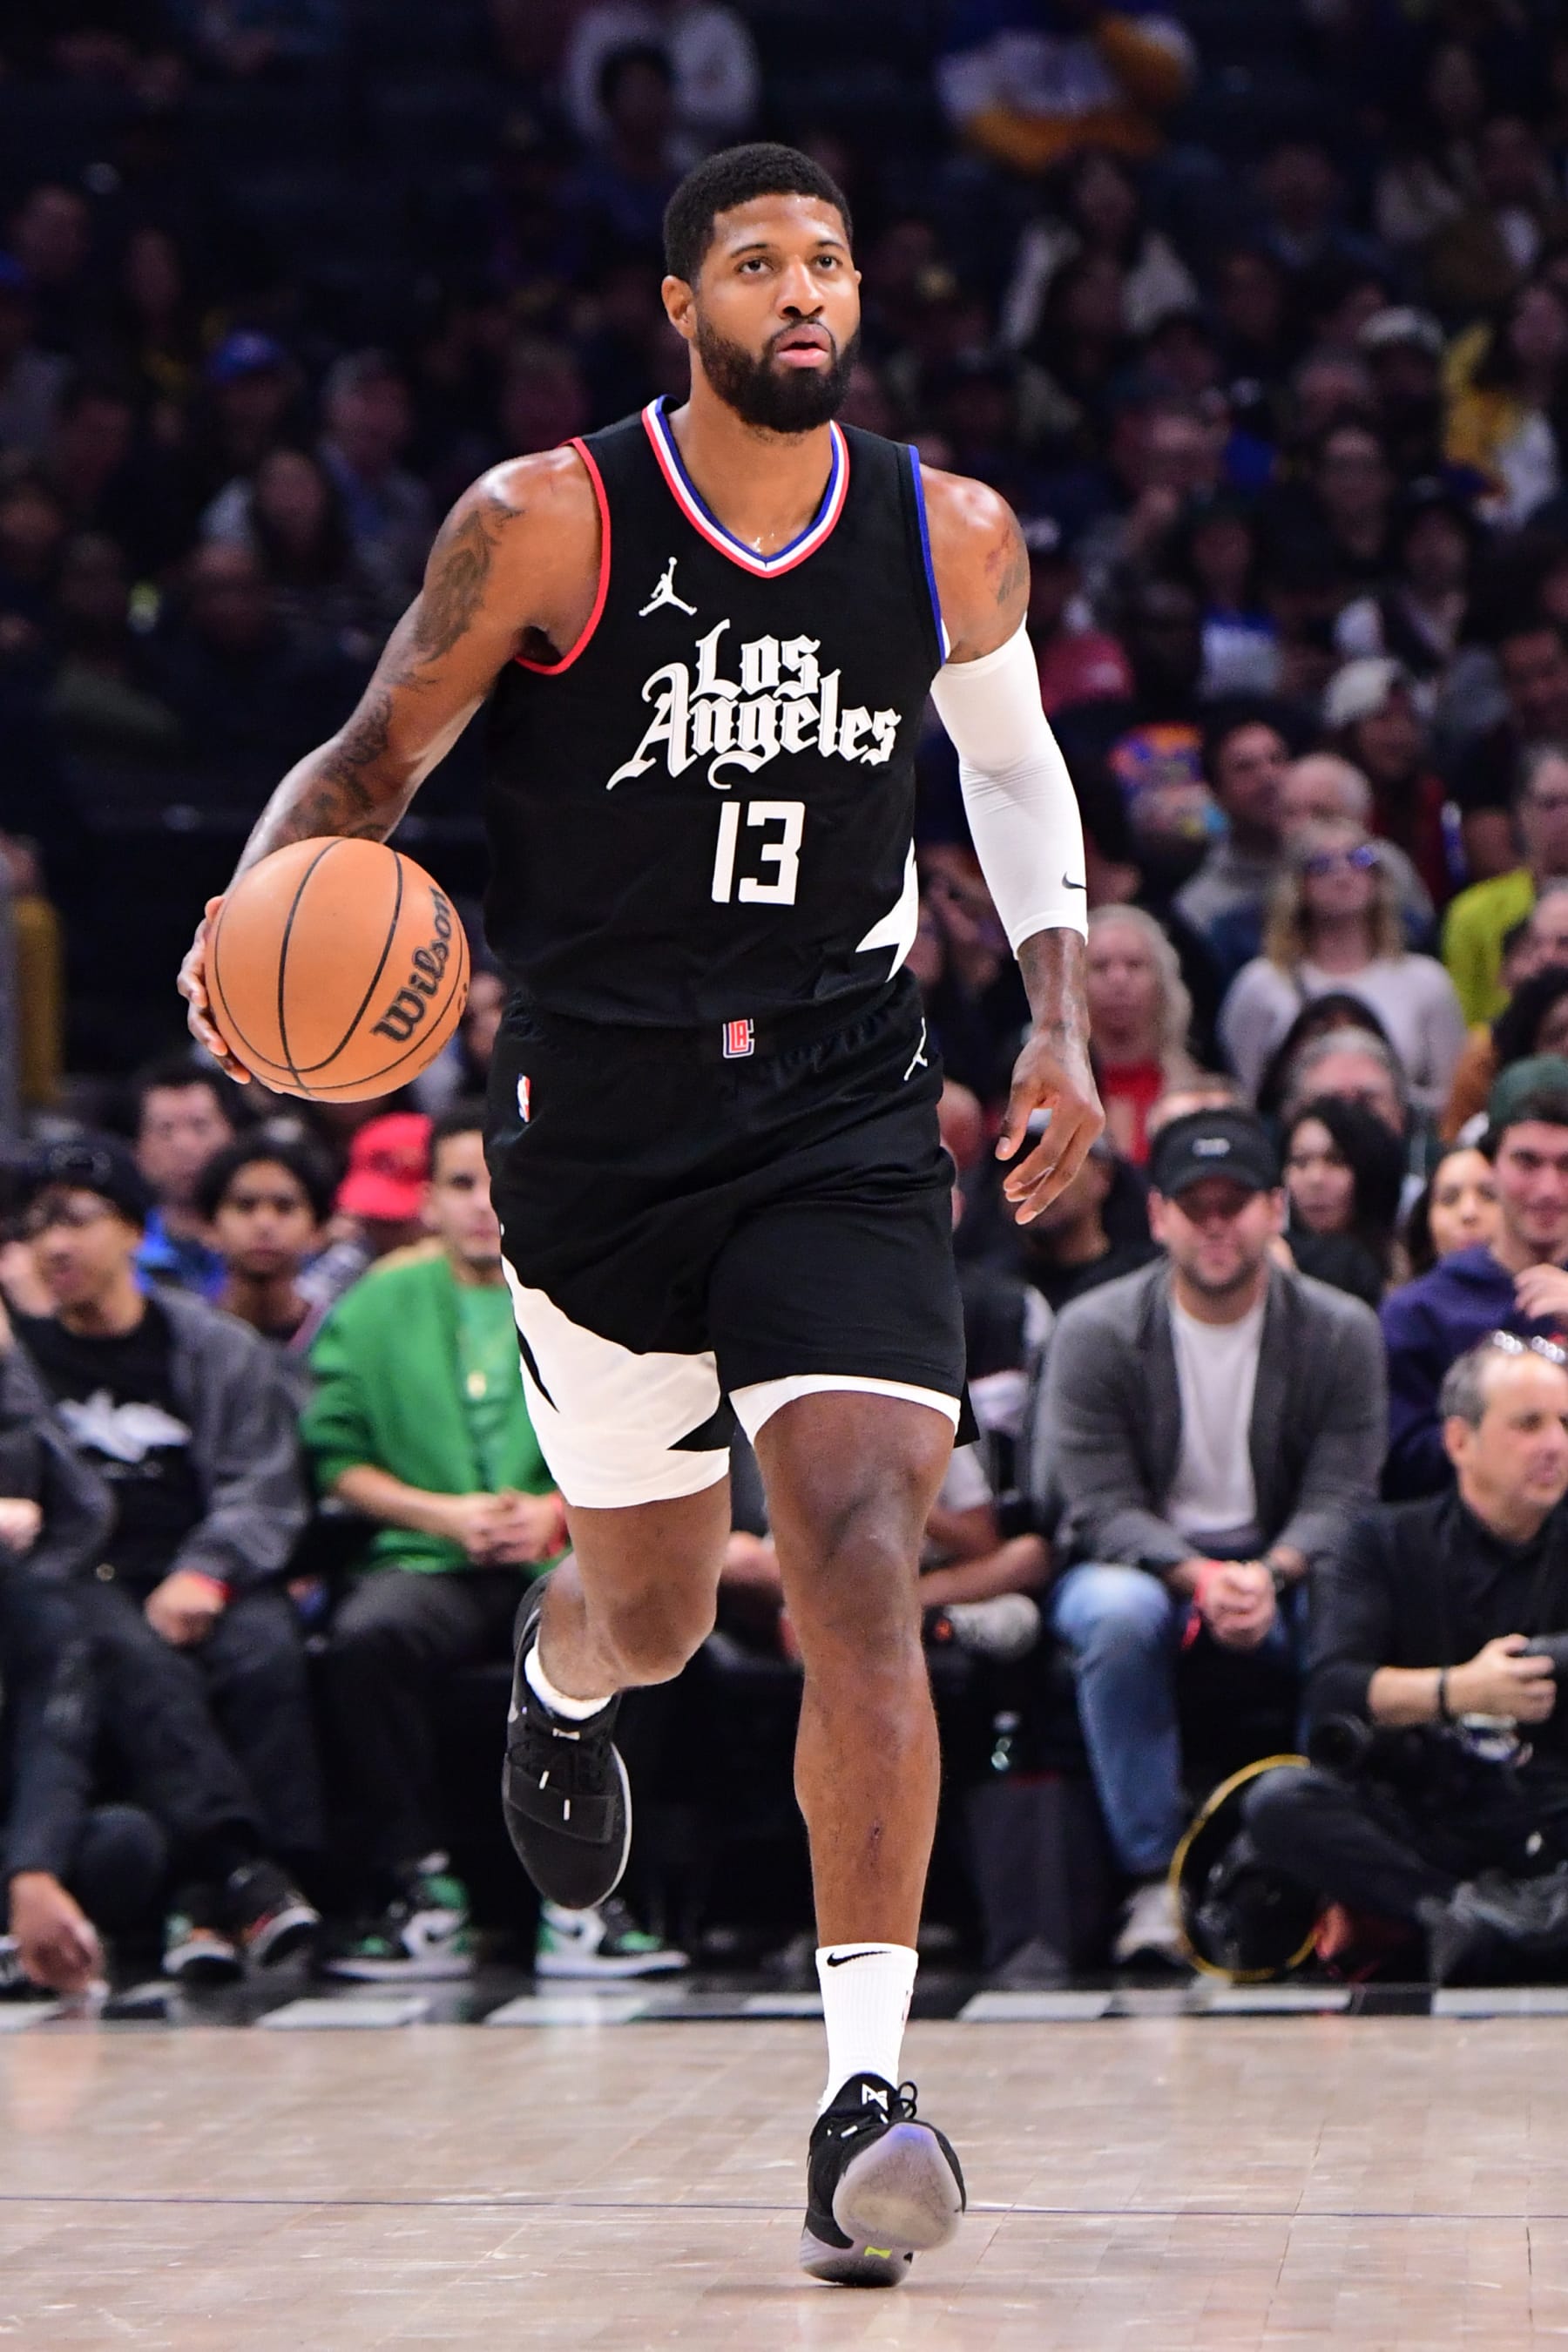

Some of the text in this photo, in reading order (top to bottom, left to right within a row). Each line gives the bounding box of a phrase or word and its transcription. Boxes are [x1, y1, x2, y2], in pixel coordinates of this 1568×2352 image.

[693, 618, 821, 701] Los
[606, 662, 902, 790] Angeles
[711, 801, 806, 906] 13
[370, 886, 452, 1042] Wilson
